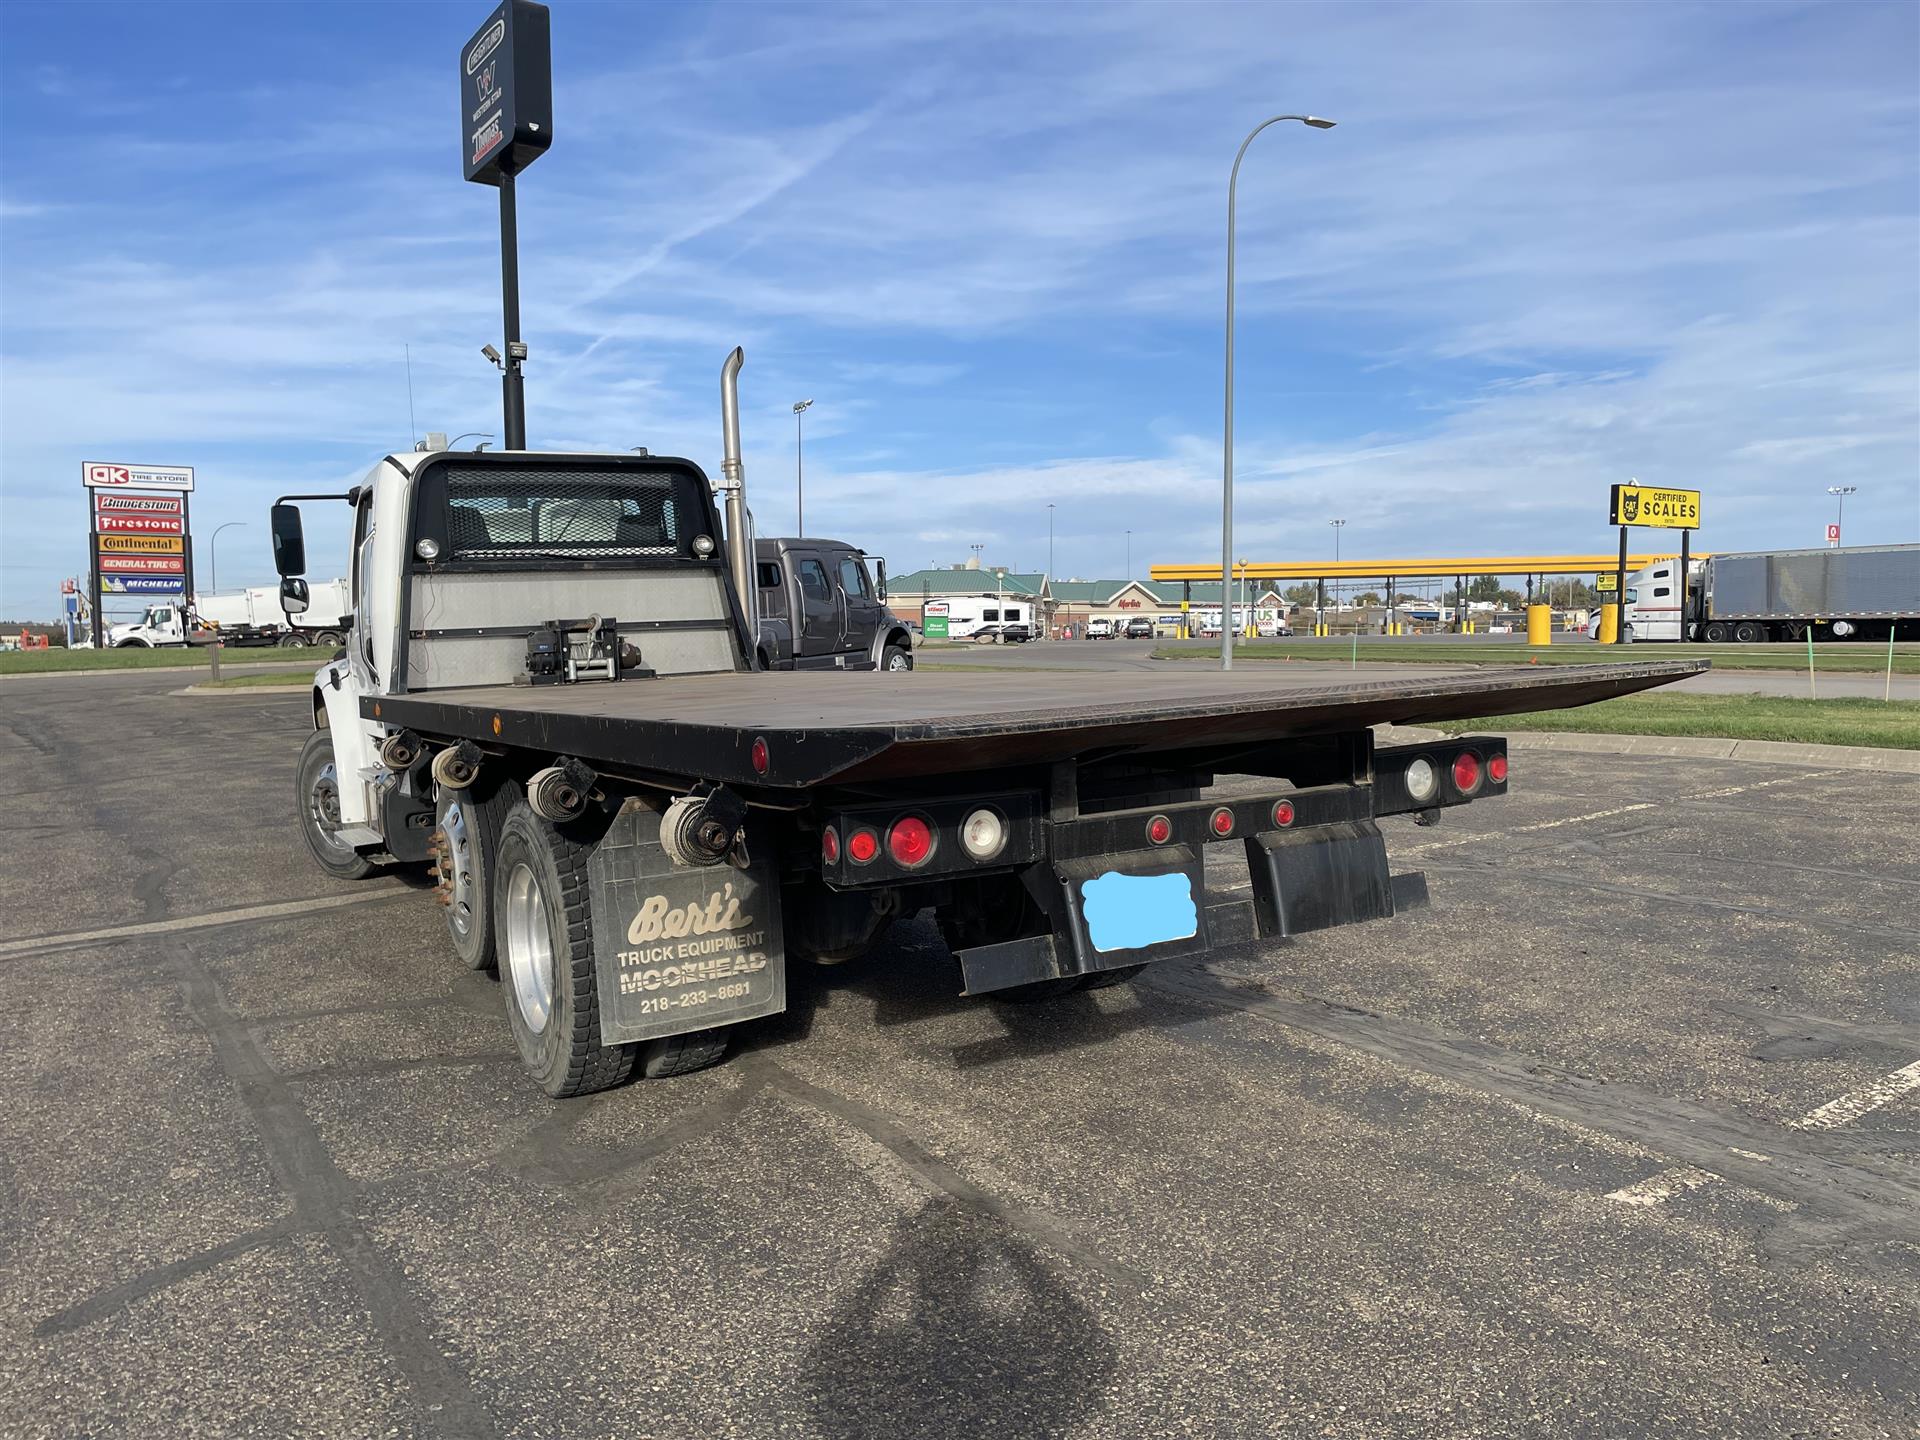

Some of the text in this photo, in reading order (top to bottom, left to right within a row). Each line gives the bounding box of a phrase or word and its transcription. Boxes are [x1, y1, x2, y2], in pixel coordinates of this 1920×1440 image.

[91, 466, 129, 484] OK
[102, 497, 178, 511] BRIDGESTONE
[1653, 492, 1687, 503] CERTIFIED
[1625, 501, 1637, 513] CAT
[1644, 502, 1696, 518] SCALES
[101, 518, 179, 530] Firestone
[103, 537, 173, 550] Continental
[104, 559, 169, 569] GENERAL TIRE
[126, 580, 182, 588] MICHELIN
[628, 882, 752, 945] Bert's
[617, 931, 765, 967] TRUCK EQUIPMENT
[641, 981, 751, 1014] 218-233-8681
